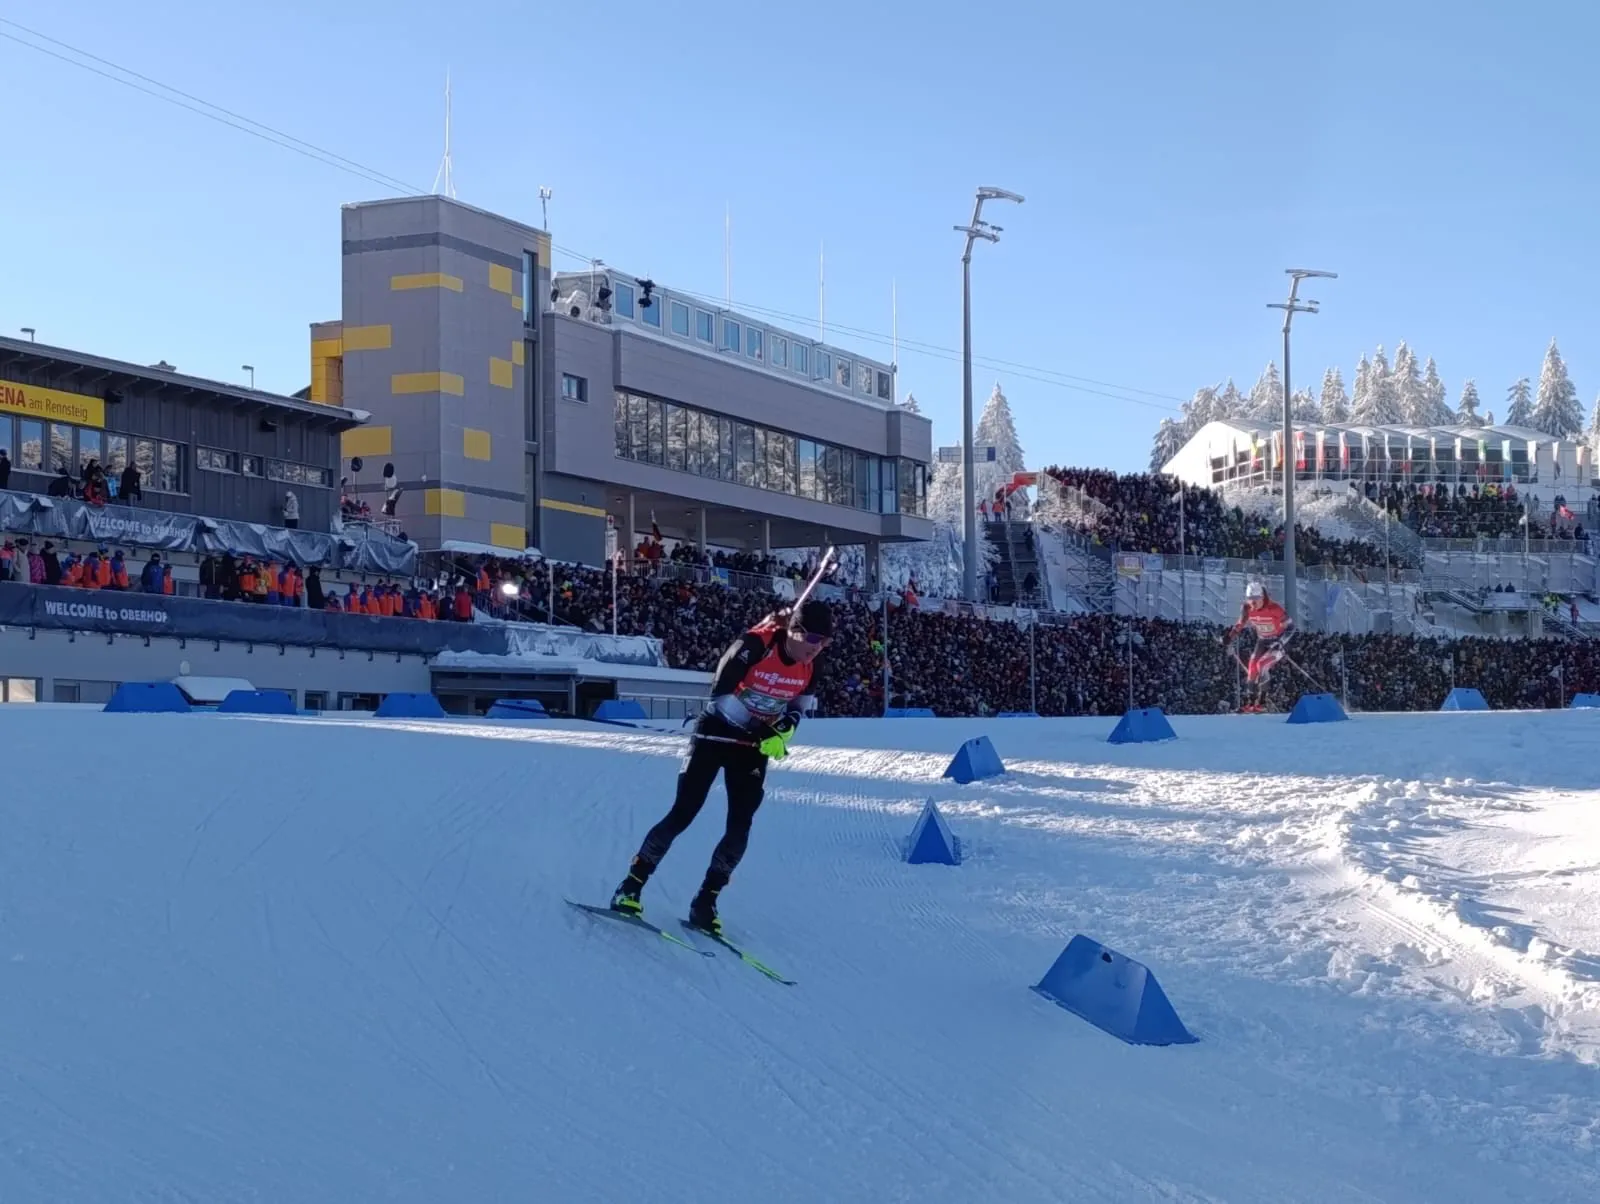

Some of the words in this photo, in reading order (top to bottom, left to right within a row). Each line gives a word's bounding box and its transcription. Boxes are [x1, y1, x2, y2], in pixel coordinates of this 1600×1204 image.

[28, 398, 43, 411] am
[45, 398, 88, 422] Rennsteig
[89, 515, 140, 532] WELCOME
[142, 523, 153, 535] to
[45, 600, 104, 619] WELCOME
[105, 608, 118, 620] to
[120, 608, 168, 623] OBERHOF
